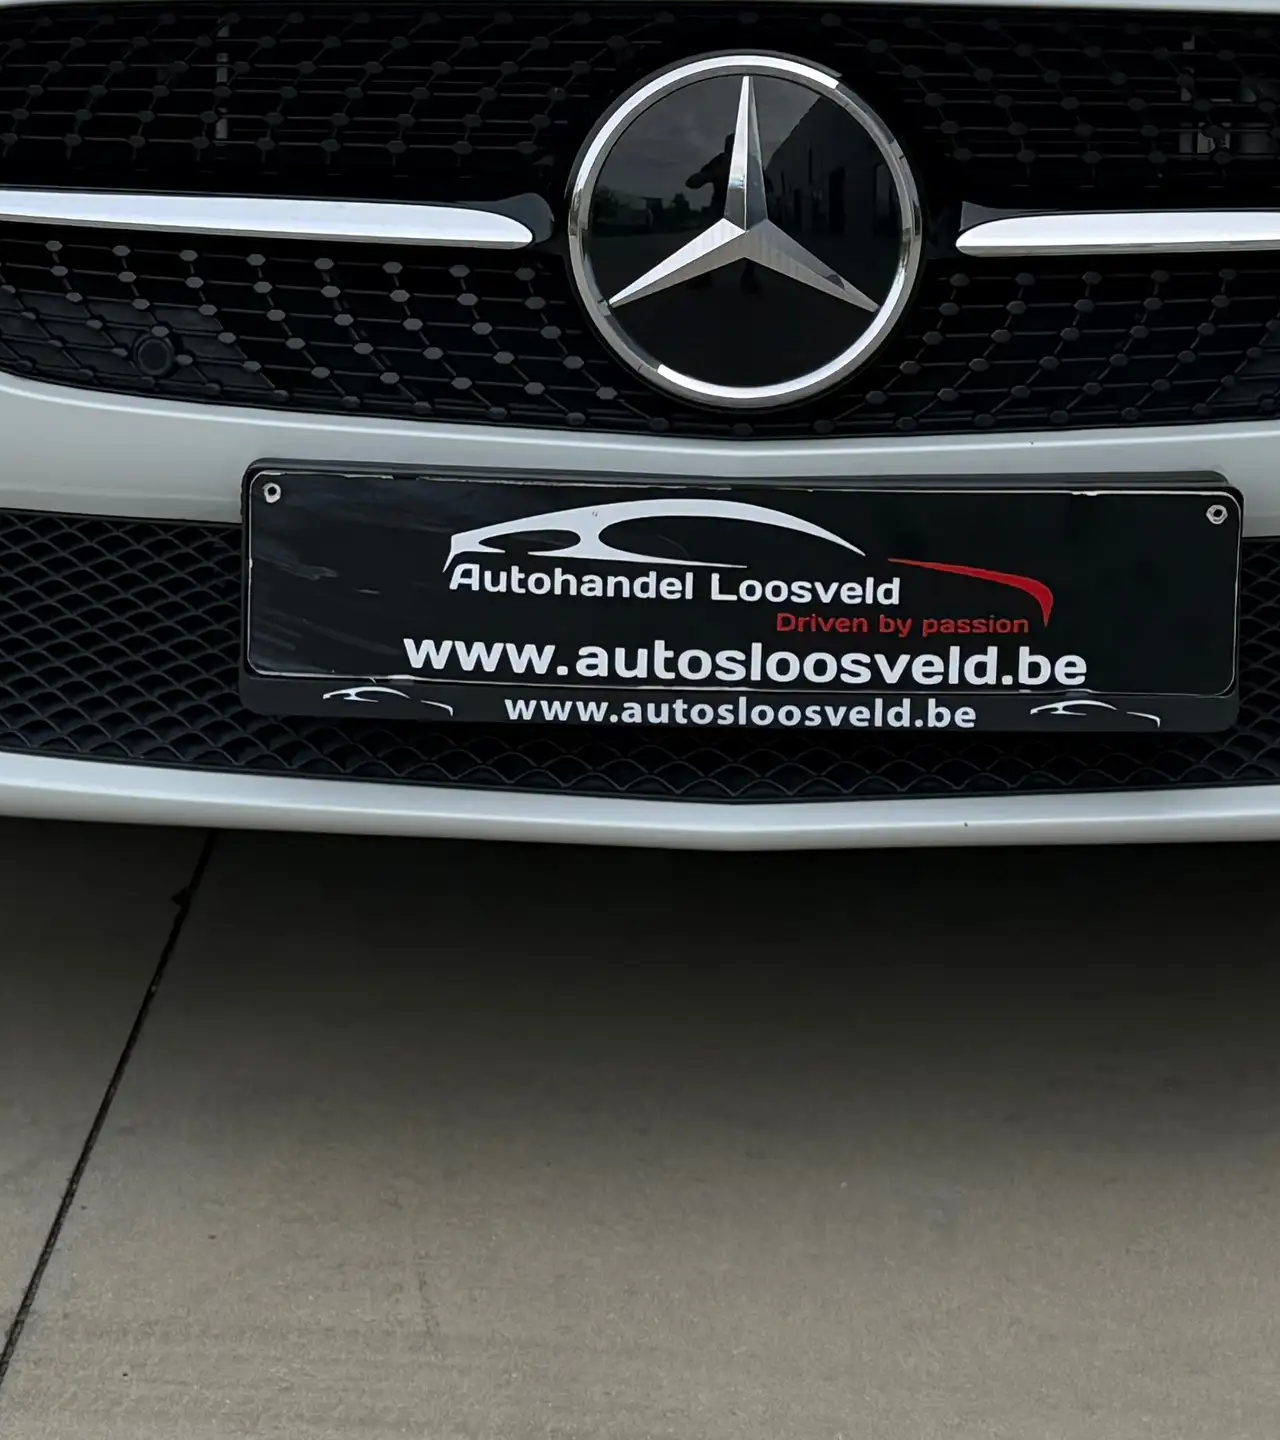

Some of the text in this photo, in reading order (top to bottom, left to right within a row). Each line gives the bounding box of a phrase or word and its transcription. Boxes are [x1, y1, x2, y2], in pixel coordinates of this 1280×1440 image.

[449, 563, 901, 605] Autohandel Loosveld
[776, 611, 1030, 639] Driven by passion
[403, 638, 1087, 686] www.autosloosveld.be
[504, 696, 977, 728] www.autosloosveld.be
